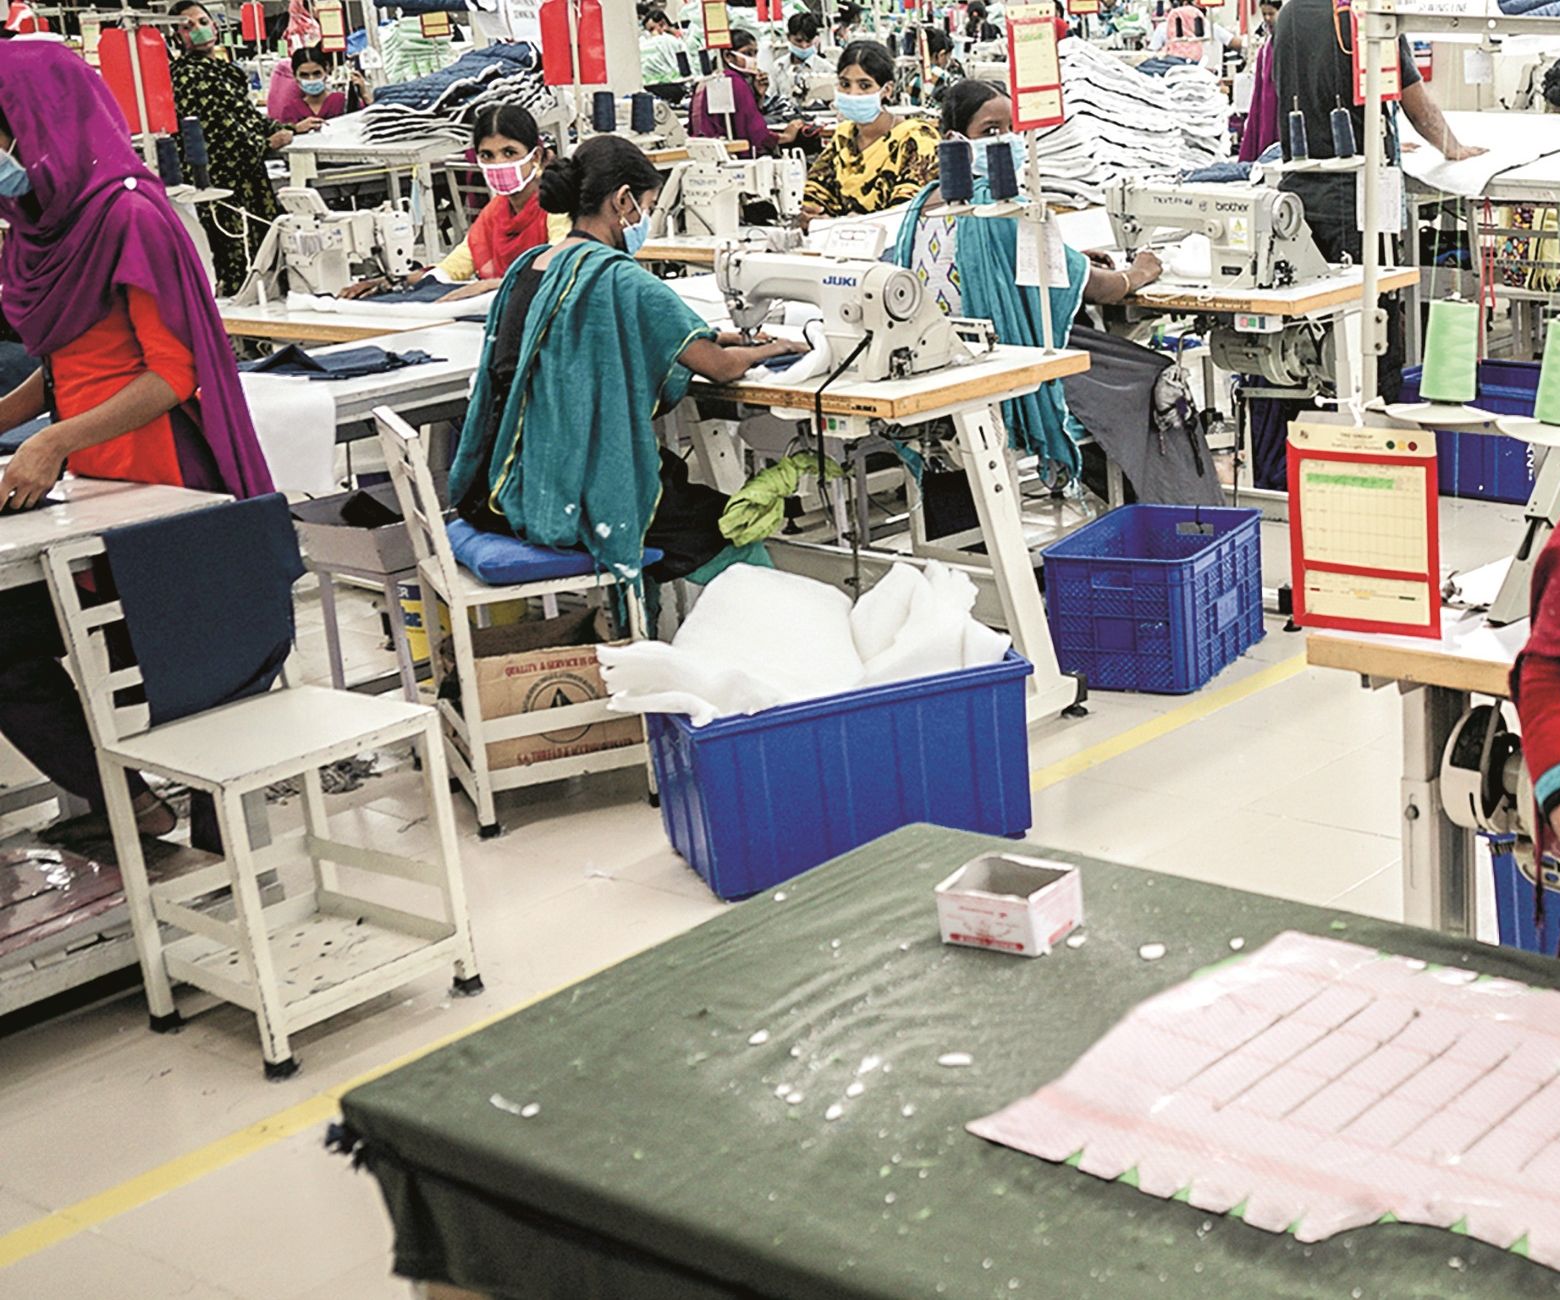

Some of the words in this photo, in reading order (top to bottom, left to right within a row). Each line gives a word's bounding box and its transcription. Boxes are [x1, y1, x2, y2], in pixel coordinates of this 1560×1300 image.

[822, 275, 857, 287] JUKI
[505, 664, 538, 677] QUALITY
[547, 658, 578, 669] SERVICE
